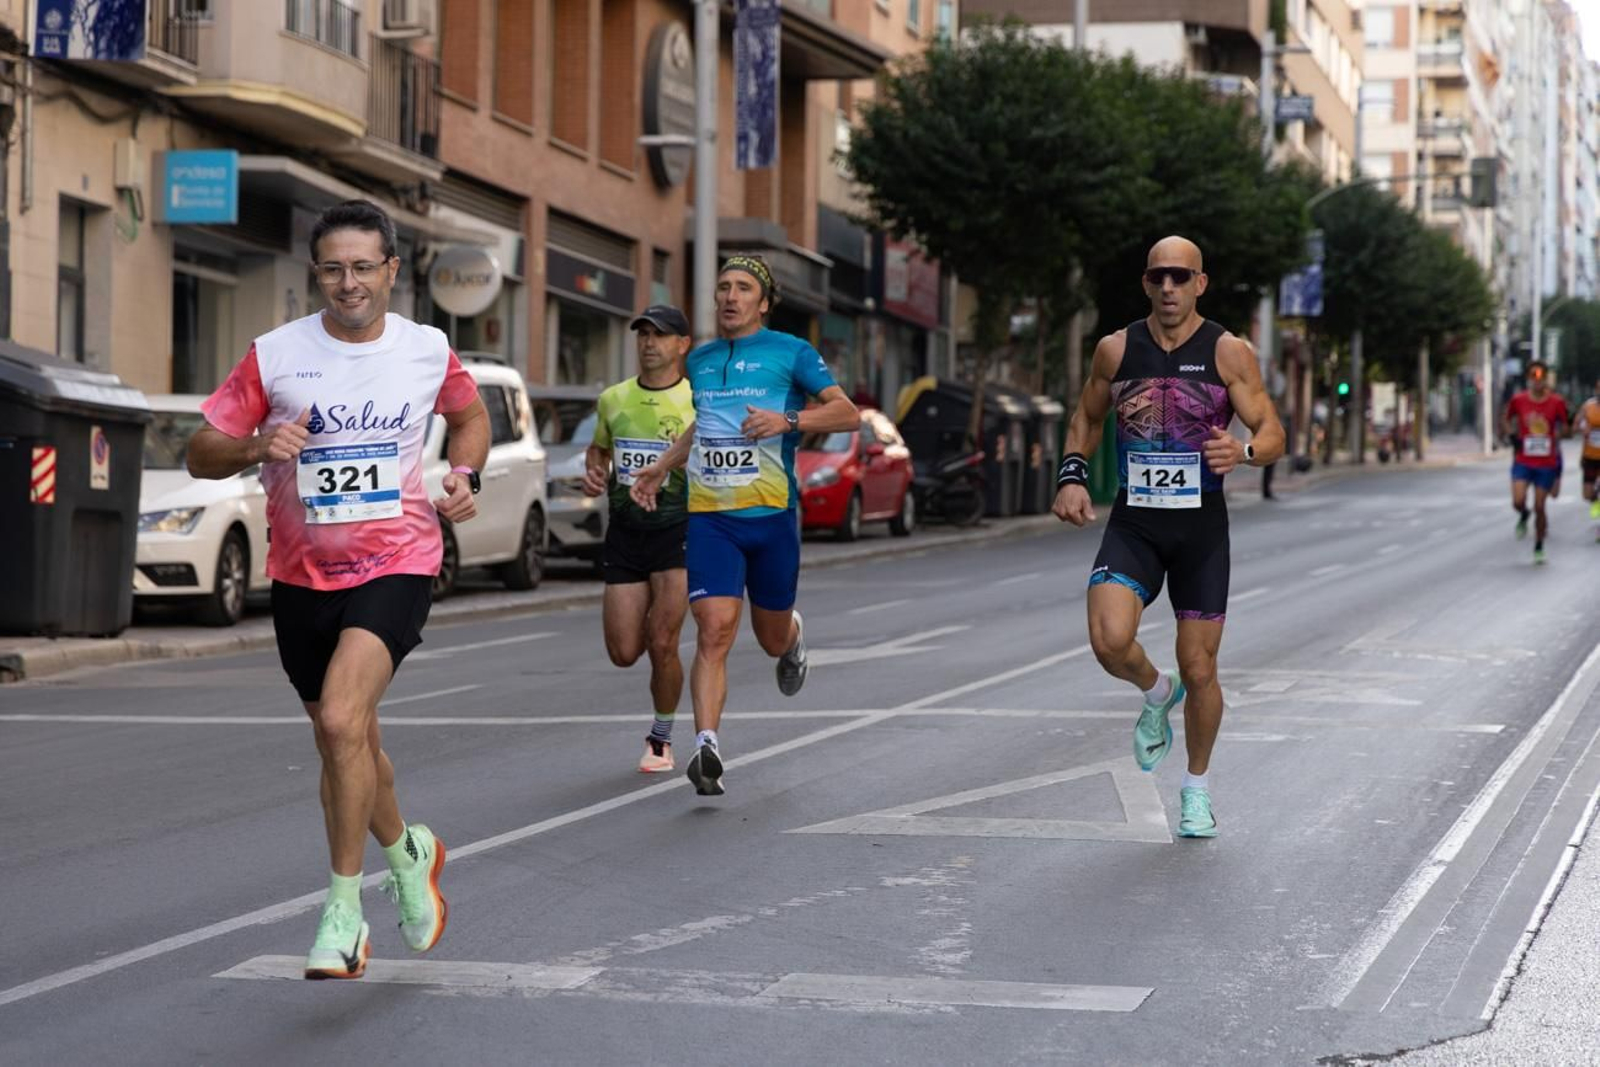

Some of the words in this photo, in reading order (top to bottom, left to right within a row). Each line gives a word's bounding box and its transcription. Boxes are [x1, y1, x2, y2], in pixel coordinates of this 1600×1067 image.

[324, 400, 411, 434] Salud
[704, 450, 753, 467] 1002
[317, 464, 379, 494] 321
[1142, 468, 1186, 487] 124
